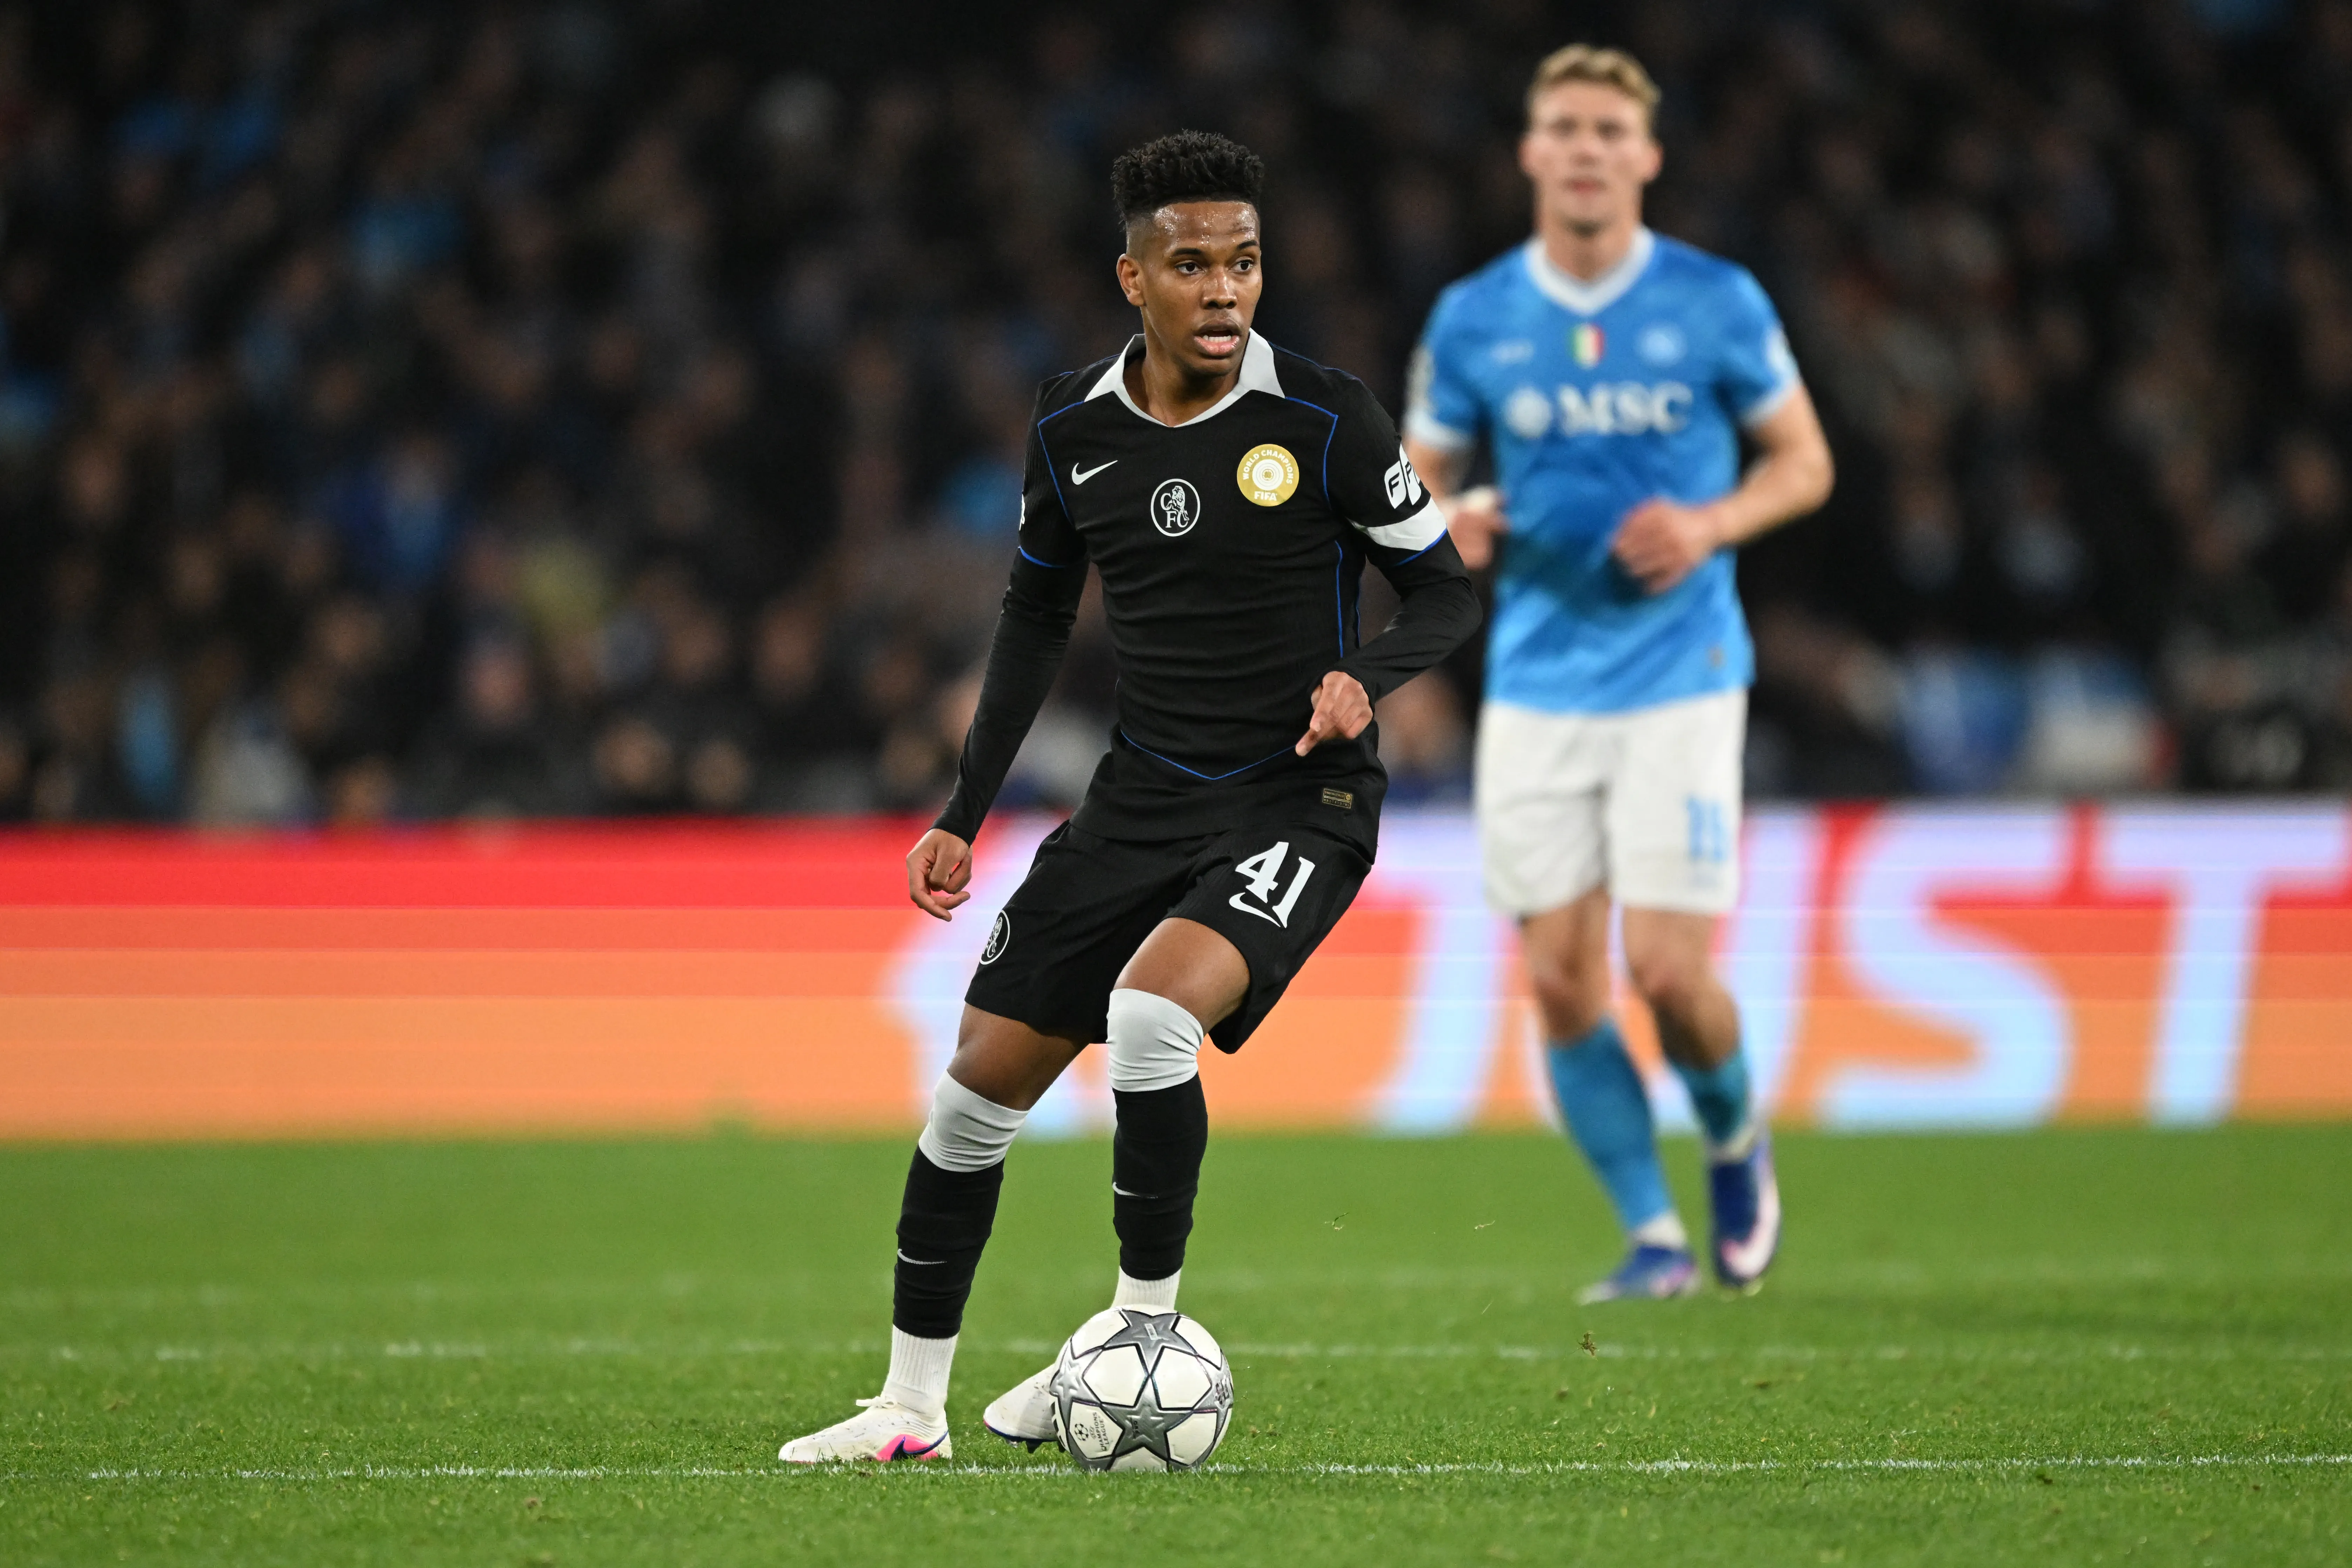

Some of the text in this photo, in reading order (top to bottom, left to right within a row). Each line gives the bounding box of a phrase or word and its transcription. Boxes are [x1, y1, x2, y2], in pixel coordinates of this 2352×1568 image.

[1558, 380, 1692, 436] MSC
[1243, 449, 1294, 484] WORLD CHAMPIONS
[1254, 491, 1277, 501] FIFA
[1235, 841, 1315, 928] 41
[1093, 1412, 1107, 1451] CHAMPIONS
[1099, 1419, 1109, 1444] LEAGUE
